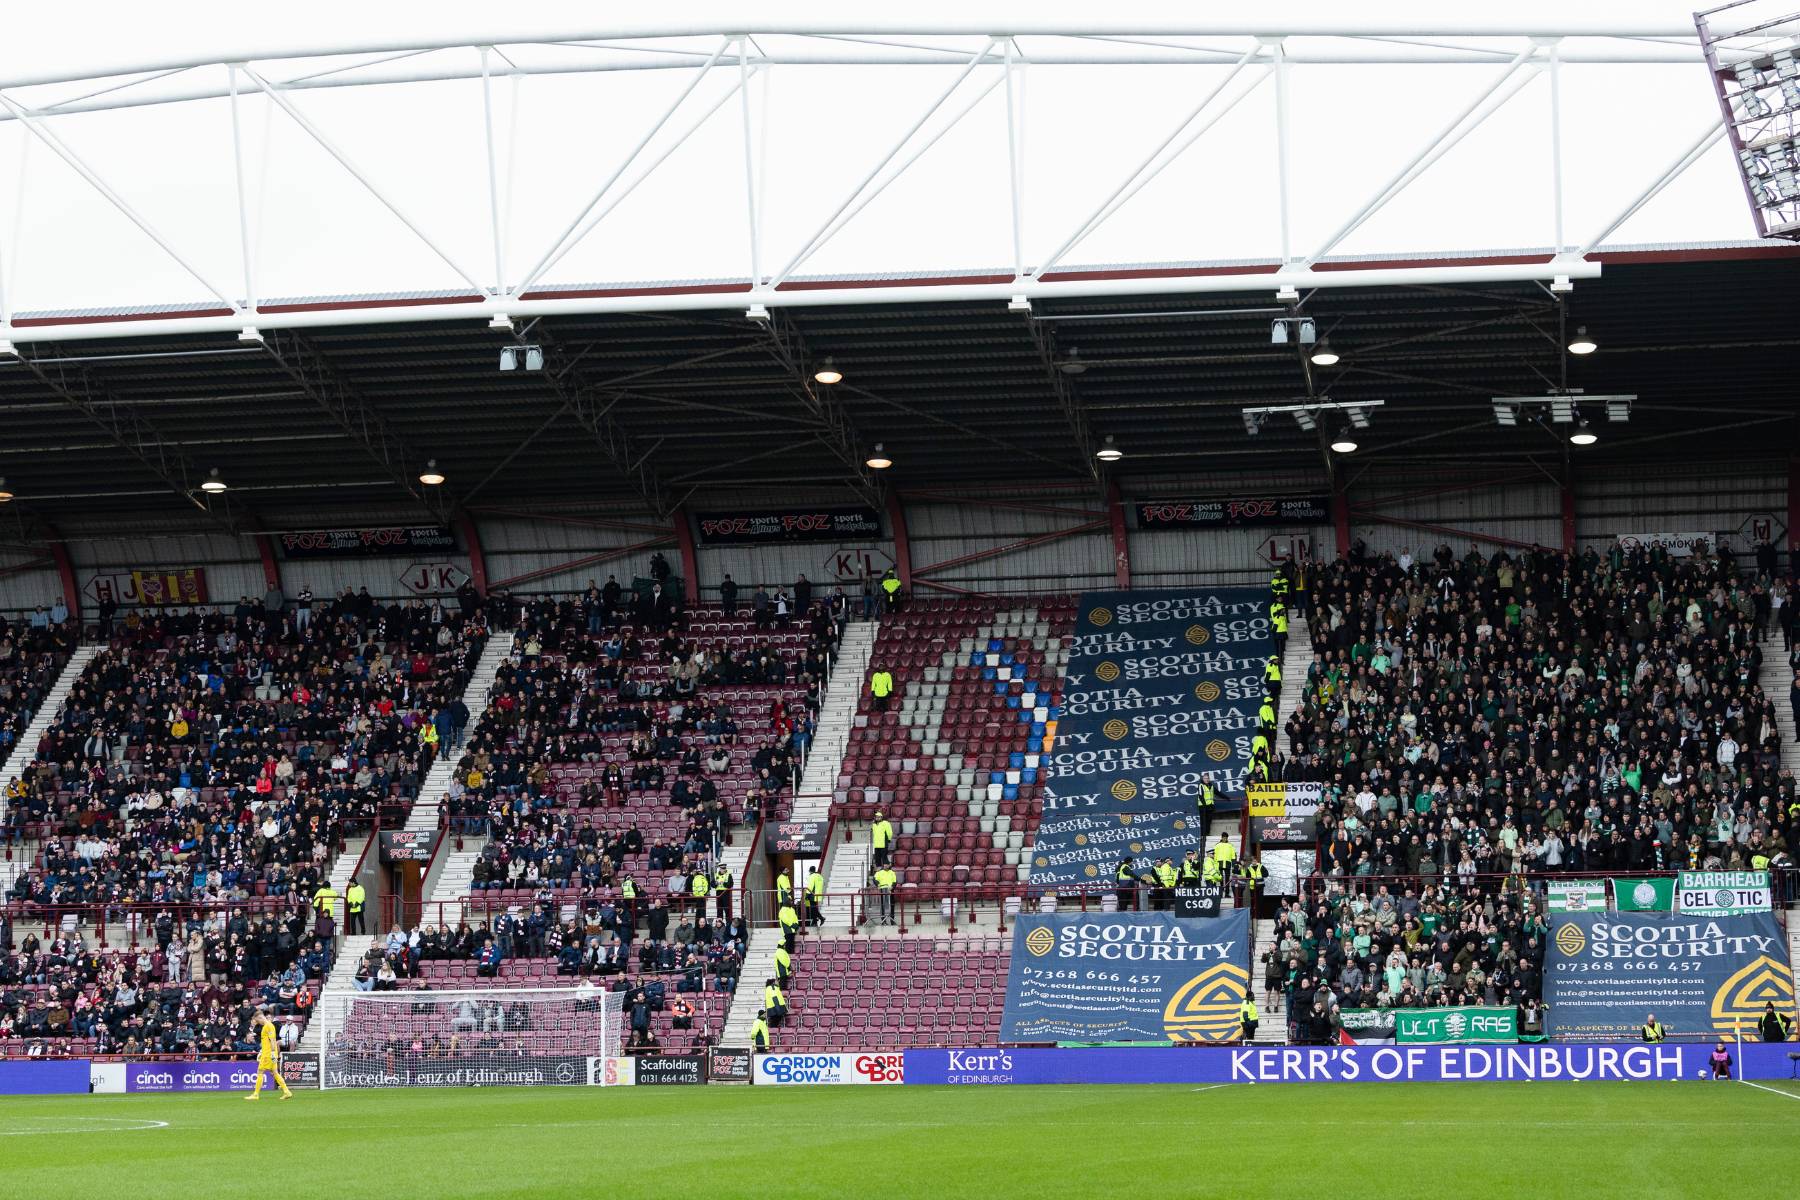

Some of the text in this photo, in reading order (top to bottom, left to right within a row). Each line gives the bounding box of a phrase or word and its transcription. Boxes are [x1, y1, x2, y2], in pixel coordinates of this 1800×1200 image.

[1143, 504, 1193, 522] FOZ
[1227, 500, 1279, 519] FOZ
[702, 518, 751, 536] FOZ
[781, 514, 831, 532] FOZ
[283, 532, 331, 550] FOZ
[359, 529, 408, 546] FOZ
[837, 554, 882, 576] K L
[415, 568, 455, 589] J K
[95, 580, 112, 600] H
[1116, 596, 1224, 615] SCOTIA
[1118, 601, 1264, 624] SECURITY
[1124, 651, 1234, 670] SCOTIA
[1132, 707, 1246, 727] SCOTIA
[1248, 784, 1322, 793] BAILLIESTON
[1252, 798, 1320, 807] BATTALION
[1040, 817, 1091, 830] SCOTIA
[1089, 828, 1160, 844] SECURITY
[1143, 833, 1197, 847] SCOTIA
[1049, 847, 1102, 861] SCOTIA
[1050, 850, 1121, 866] SECURITY
[1683, 872, 1766, 887] BARRHEAD
[1175, 887, 1220, 897] NEILSTON
[1684, 891, 1762, 907] CEL TIC
[1060, 924, 1189, 943] SCOTIA
[1591, 921, 1726, 943] SCOTIA
[1058, 941, 1235, 960] SECURITY
[1591, 935, 1775, 958] SECURITY
[1557, 962, 1702, 972] 07368 666 457
[1086, 971, 1120, 982] 666
[1128, 975, 1161, 984] 457
[1022, 979, 1162, 993] www.scotiasecurityltd.com
[1556, 989, 1705, 997] info@scotiasecurityltd.com
[1020, 988, 1160, 1004] info@scotiasecurityltd.com
[1556, 1000, 1706, 1008] recruitment@scotiasecurityltd.com
[1471, 1016, 1511, 1032] RAS
[641, 1059, 698, 1071] Scaffolding
[762, 1056, 841, 1076] GORDON
[948, 1050, 1013, 1071] Kerr's
[1232, 1046, 1682, 1080] KERR'S OF EDINBURGH
[136, 1070, 173, 1085] cinch
[183, 1069, 220, 1084] cinch
[447, 1069, 463, 1083] of
[641, 1074, 698, 1083] 0131 664 4125
[771, 1065, 821, 1082] BOW
[948, 1074, 1013, 1083] OF EDINBURGH
